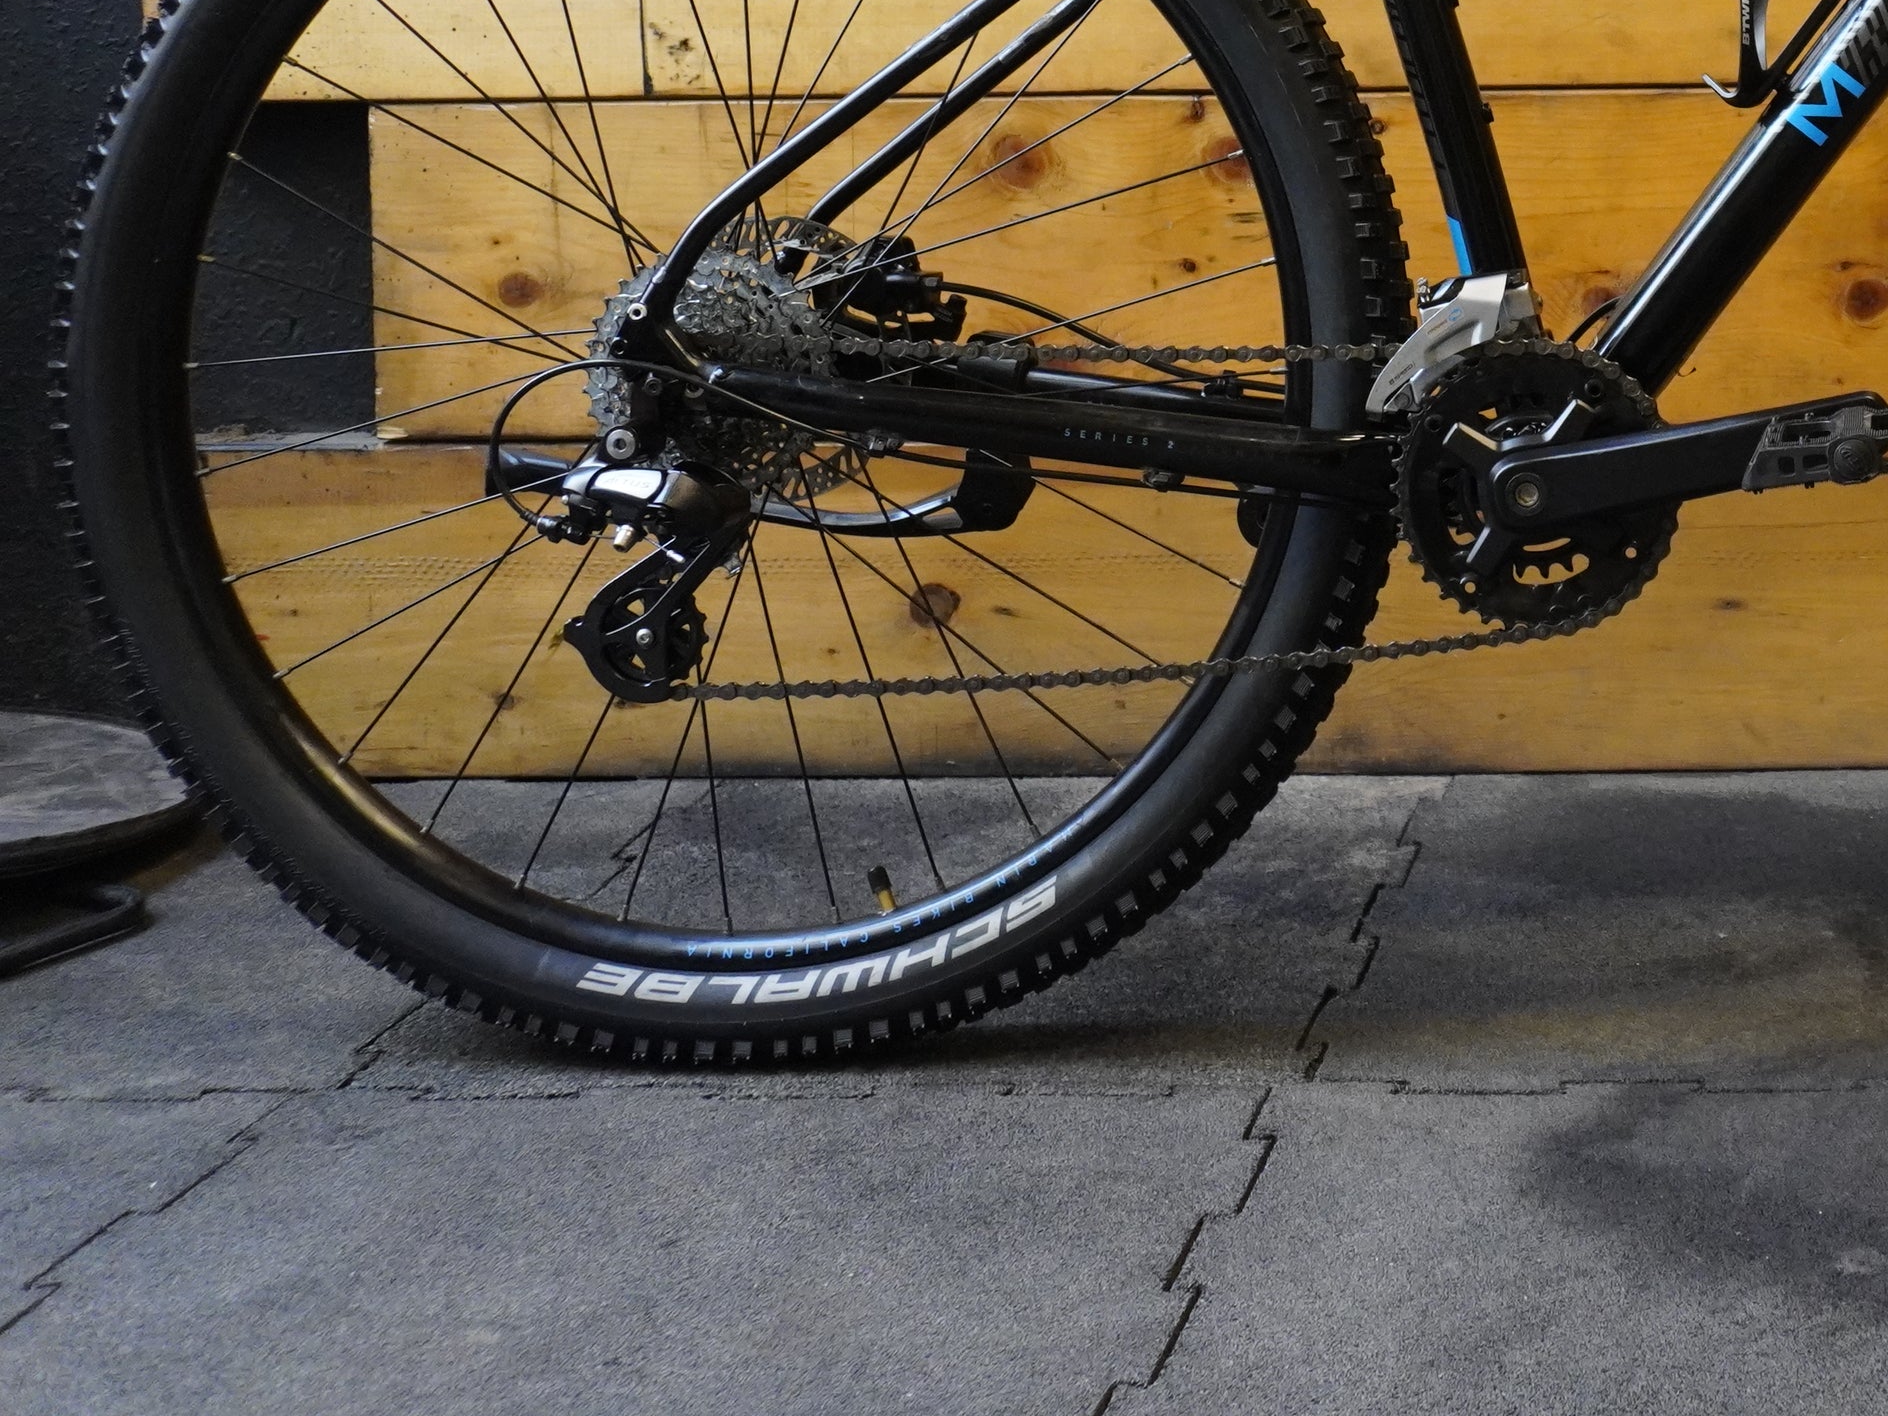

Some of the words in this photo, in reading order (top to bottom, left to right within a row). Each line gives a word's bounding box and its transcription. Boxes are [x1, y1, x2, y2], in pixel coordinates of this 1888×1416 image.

[1063, 427, 1149, 446] SERIES
[1167, 440, 1175, 449] 2
[892, 893, 974, 933] BIKES
[576, 874, 1058, 1005] SCHWALBE
[686, 932, 869, 960] CALIFORNIA
